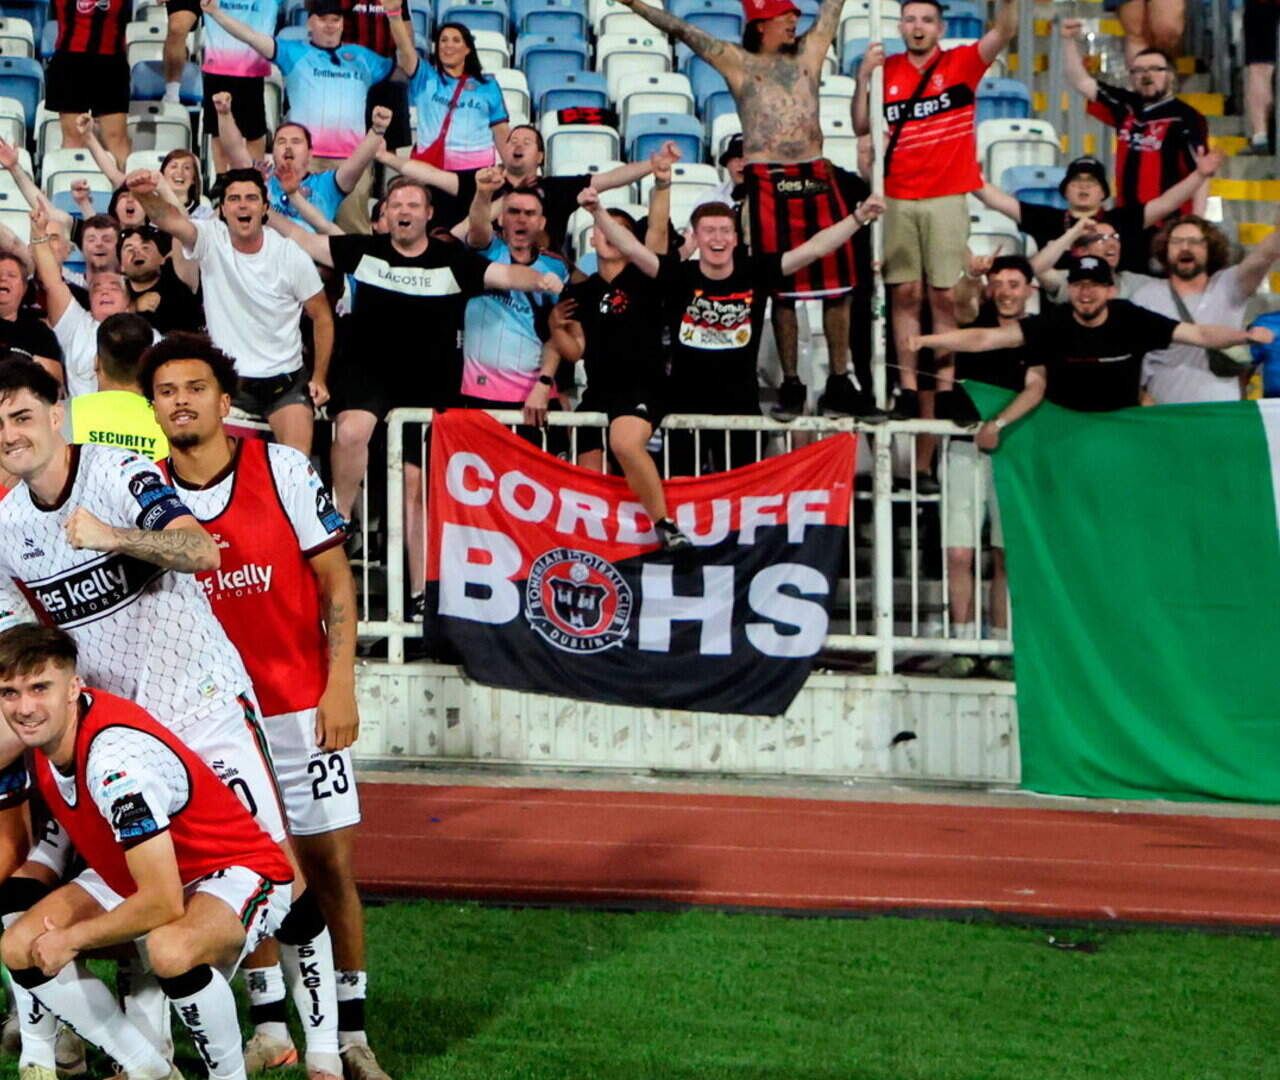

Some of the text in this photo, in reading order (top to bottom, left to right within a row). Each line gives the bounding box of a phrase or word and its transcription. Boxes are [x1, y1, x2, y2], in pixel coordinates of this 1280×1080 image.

[777, 179, 802, 192] des
[377, 268, 432, 288] LACOSTE
[88, 430, 157, 449] SECURITY
[445, 451, 831, 548] CORDUFF
[143, 505, 166, 531] SPECT
[68, 563, 131, 605] kelly
[216, 563, 272, 593] kelly
[549, 630, 604, 649] DUBLIN
[307, 753, 349, 801] 23
[300, 961, 324, 1028] kelly
